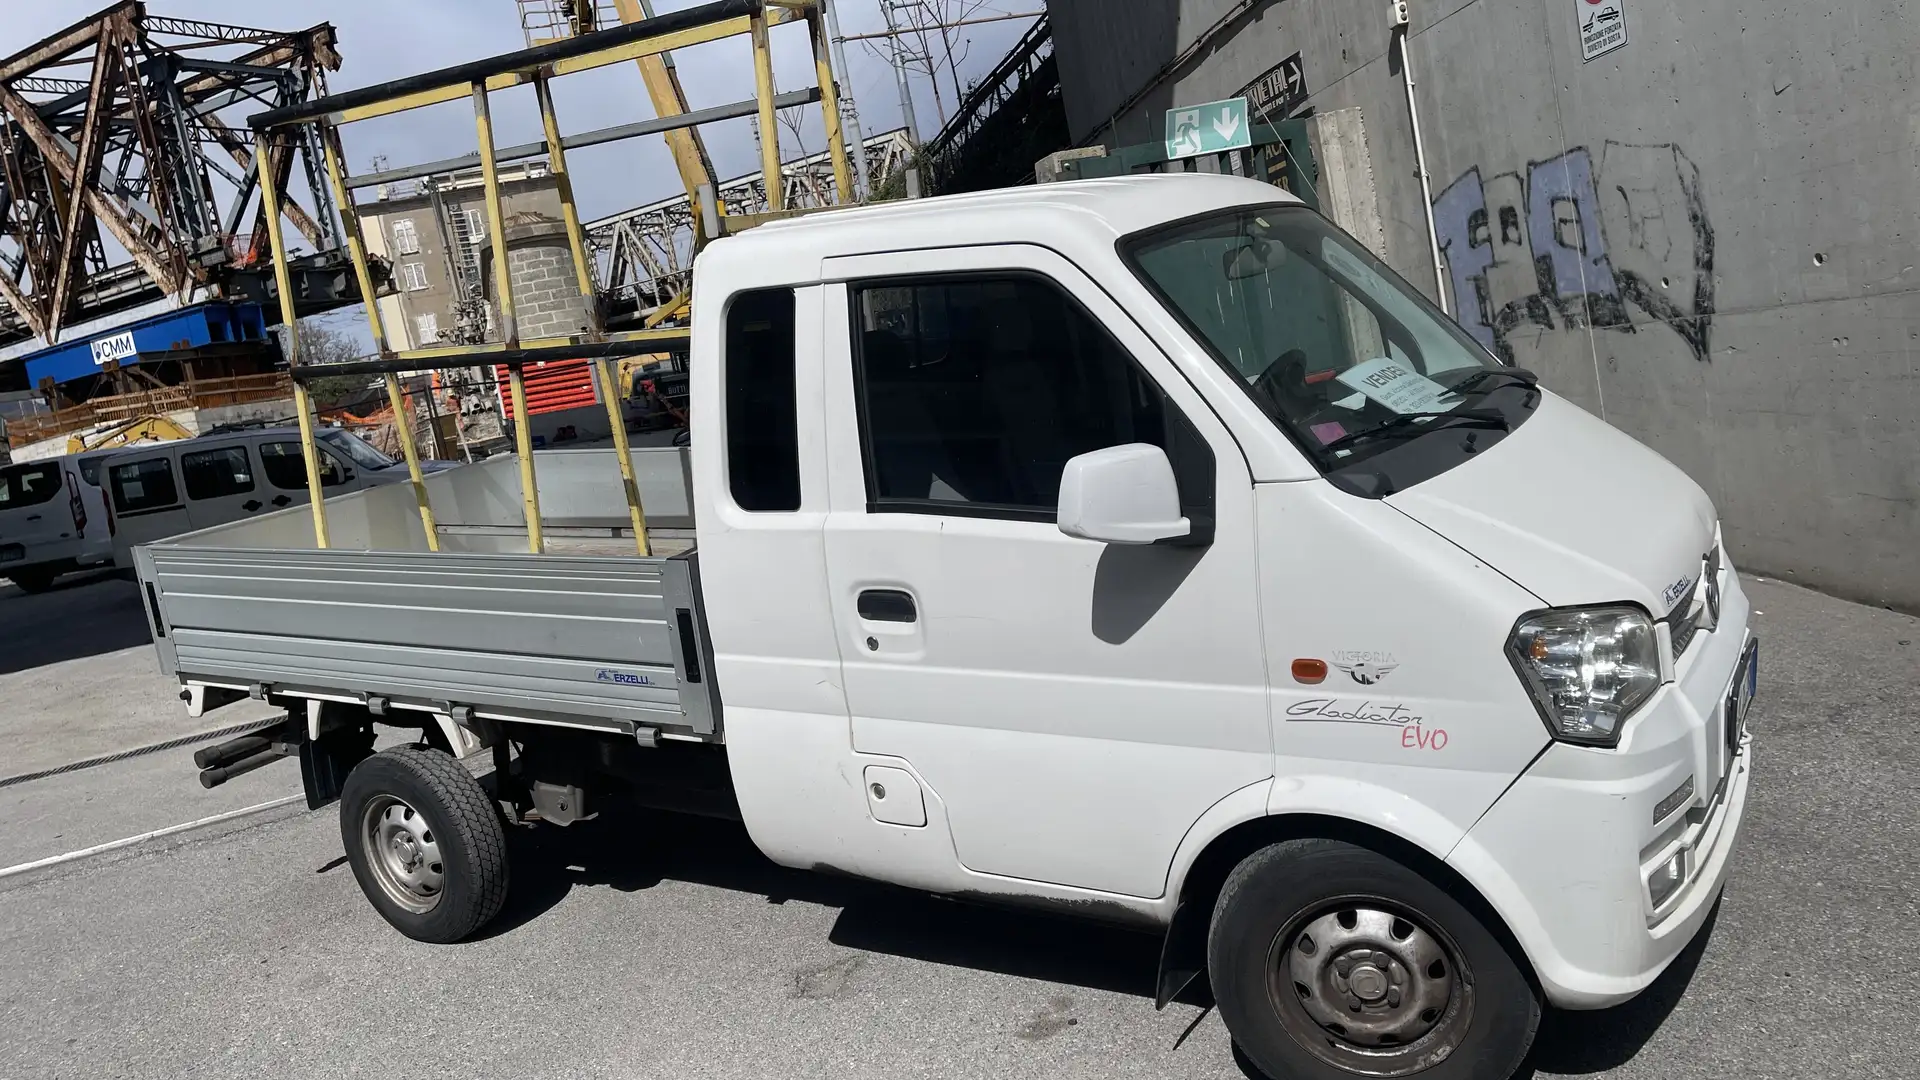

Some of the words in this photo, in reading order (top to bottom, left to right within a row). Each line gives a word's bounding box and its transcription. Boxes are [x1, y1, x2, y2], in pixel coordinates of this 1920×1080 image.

[1588, 40, 1602, 53] DIVIETO
[1607, 31, 1621, 45] SOSTA
[101, 335, 133, 358] CMM
[114, 433, 125, 444] CAT
[1331, 650, 1398, 663] VICTORIA
[614, 673, 648, 685] ERZELLI
[1286, 699, 1423, 726] Gladiator
[1402, 726, 1449, 751] EVO
